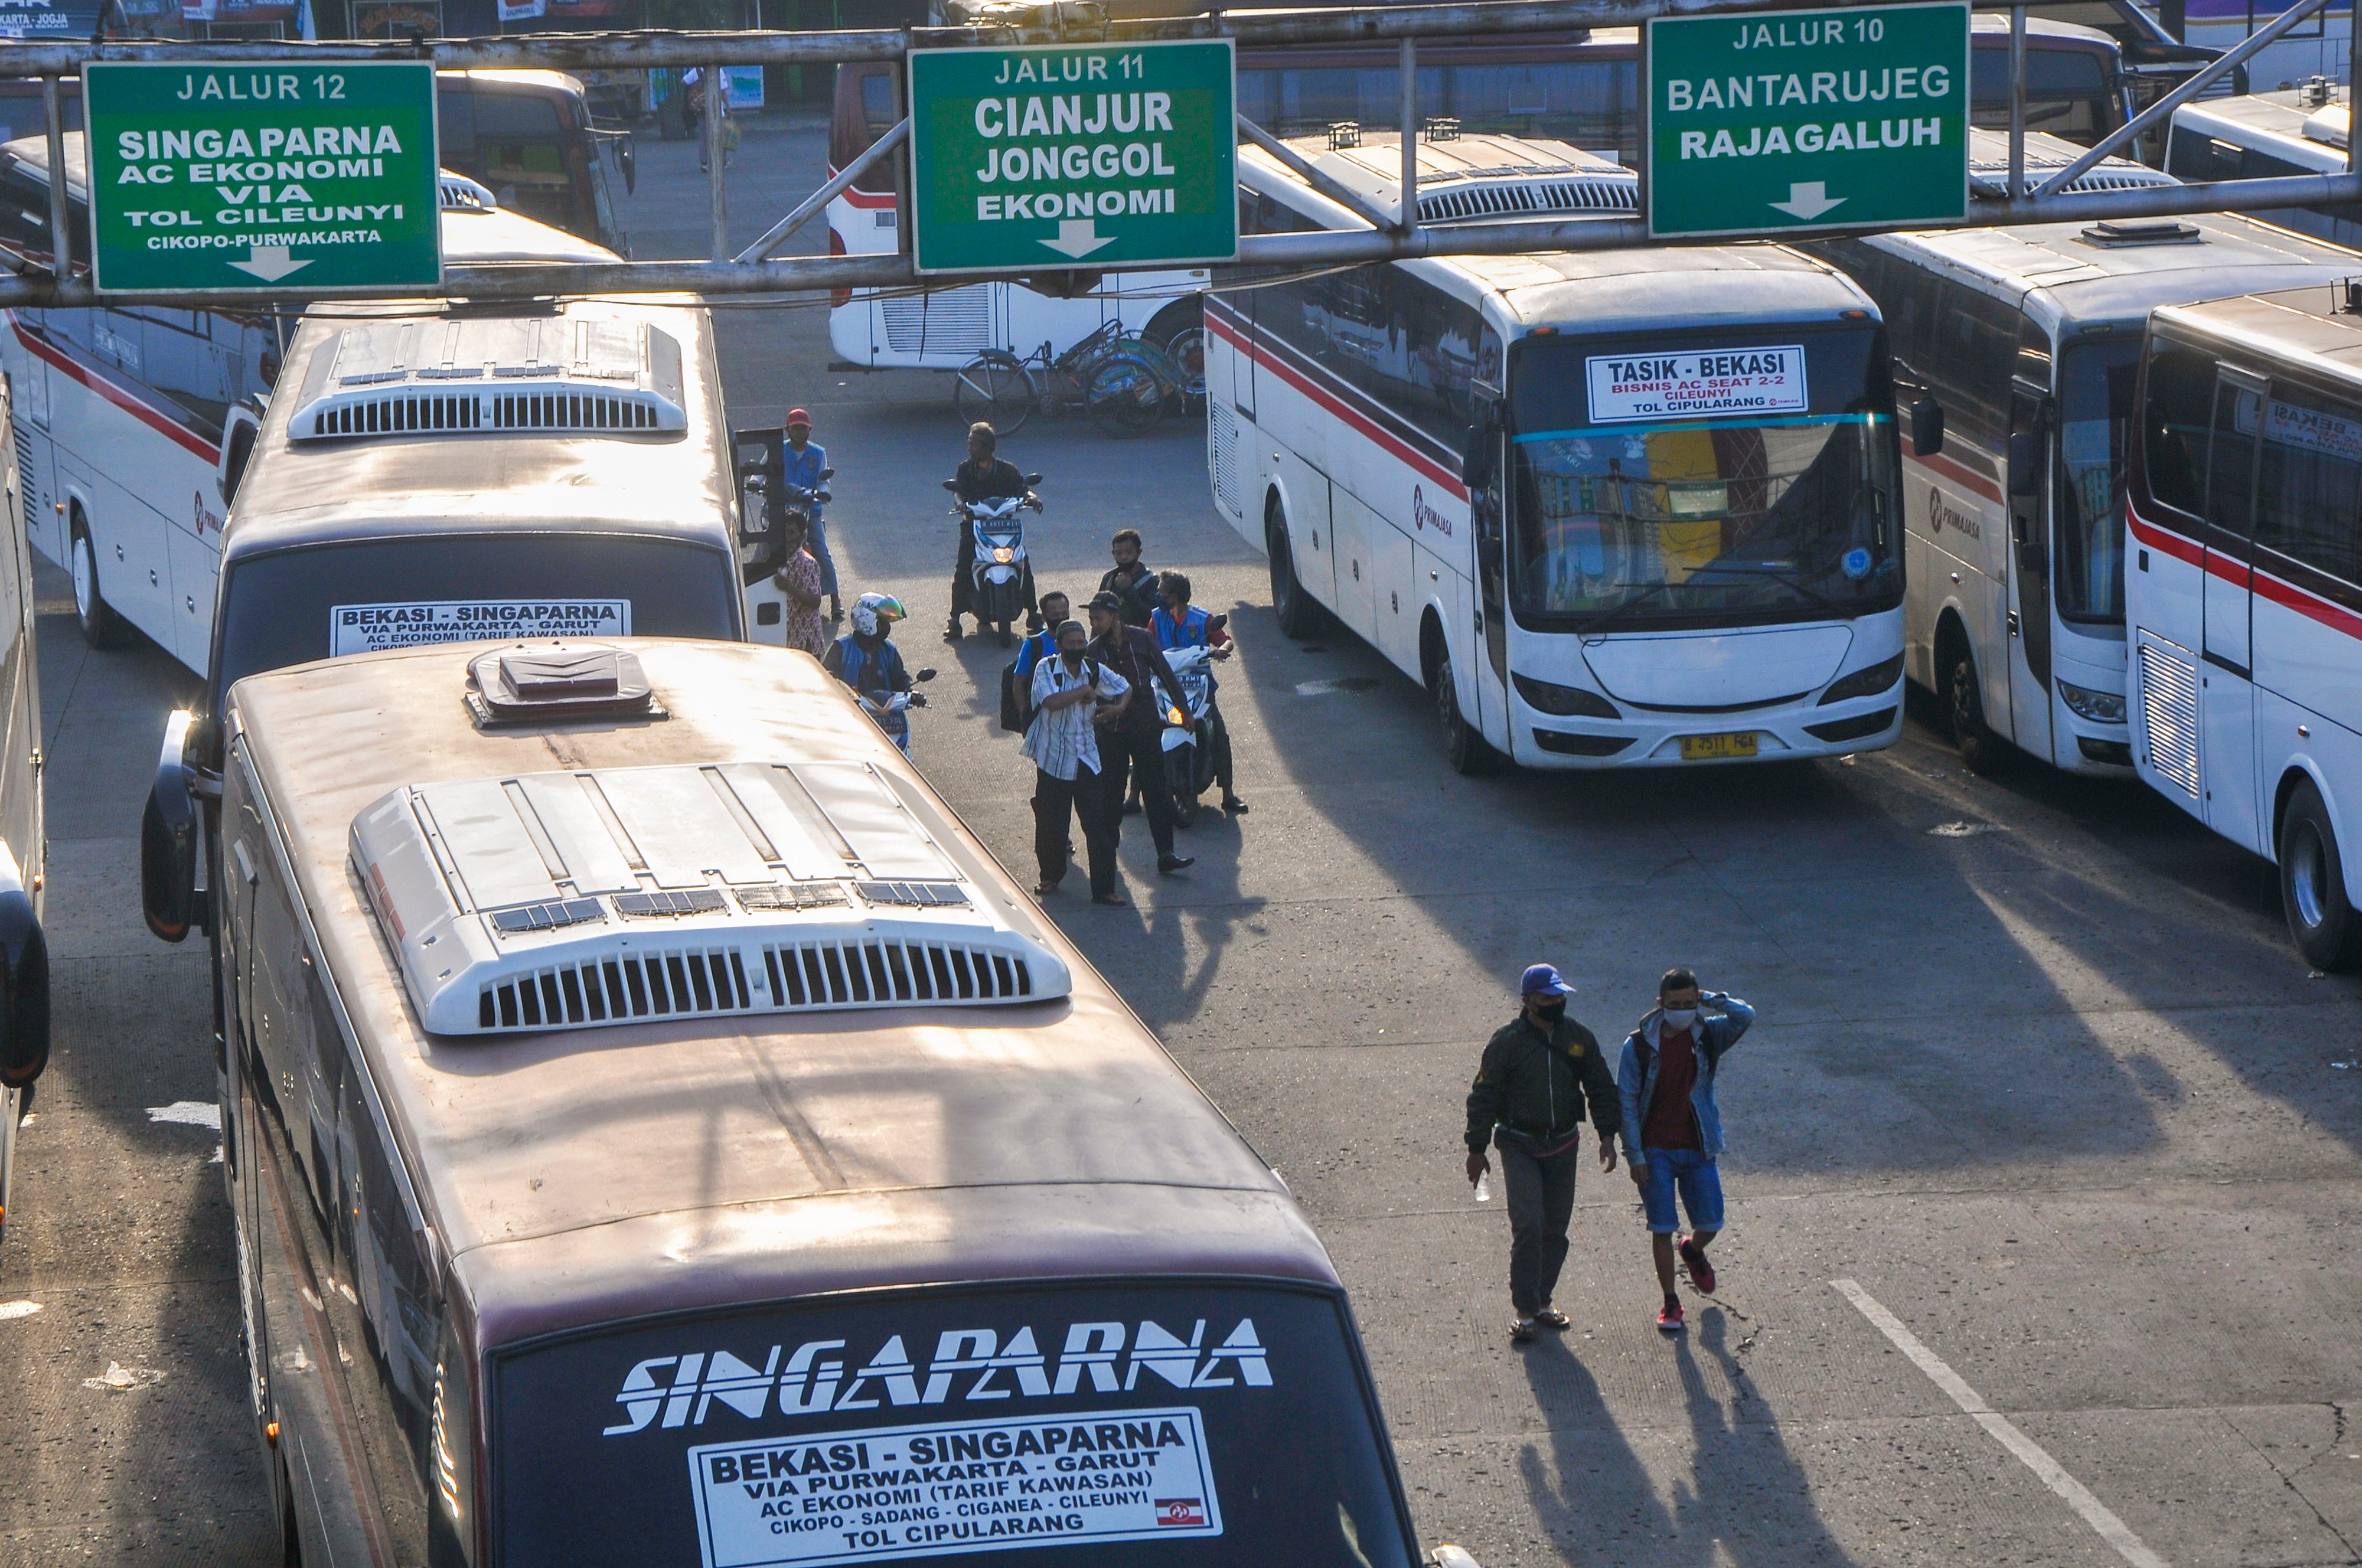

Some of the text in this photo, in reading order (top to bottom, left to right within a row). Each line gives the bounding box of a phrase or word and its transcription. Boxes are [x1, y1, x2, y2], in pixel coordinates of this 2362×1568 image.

[37, 13, 67, 24] JOGJA
[1733, 18, 1884, 50] JALUR 10
[994, 54, 1144, 84] JALUR 11
[177, 74, 345, 100] JALUR 12
[1668, 65, 1950, 112] BANTARUJEG
[974, 92, 1173, 138] CIANJUR
[118, 125, 402, 161] SINGAPARNA
[1681, 117, 1940, 159] RAJAGALUH
[118, 158, 383, 184] AC EKONOMI
[977, 142, 1175, 182] JONGGOL
[214, 184, 312, 204] VIA
[977, 188, 1175, 221] EKONOMI
[123, 204, 404, 227] TOL CILEUNYI
[147, 230, 381, 250] CIKOPO-PURWAKARTA
[1608, 360, 1678, 383] TASIK
[1699, 354, 1785, 377] BEKASI
[1611, 376, 1784, 393] BISNIS AC SEAT 2-2
[1633, 397, 1765, 413] TOL CIPULARANG
[1665, 389, 1731, 400] CILEUNYI
[1424, 505, 1452, 538] PRIMAJASA
[1943, 507, 1979, 540] PRIMAJASA
[342, 608, 433, 625] BEKASI
[456, 606, 615, 620] SINGAPARNA
[396, 621, 521, 632] PURWAKARTA
[539, 620, 600, 629] GARUT
[367, 635, 385, 643] AC
[392, 632, 459, 642] EKONOMI
[465, 631, 510, 640] (TARIF
[602, 1318, 1274, 1435] SINGAPARNA
[710, 1439, 869, 1484] BEKASI
[910, 1422, 1186, 1468] SINGAPARNA
[743, 1478, 794, 1500] VIA
[807, 1459, 1027, 1495] PURWAKARTA
[1055, 1451, 1161, 1472] GARUT
[760, 1471, 1154, 1518] AC EKONOMI (TARIF KAWASAN)
[771, 1517, 843, 1534] CIKOPO
[860, 1507, 940, 1526] SADANG
[958, 1498, 1042, 1518] CIGANEA
[1059, 1491, 1149, 1511] CILEUNYI
[843, 1514, 1083, 1550] TOL CIPULARANG
